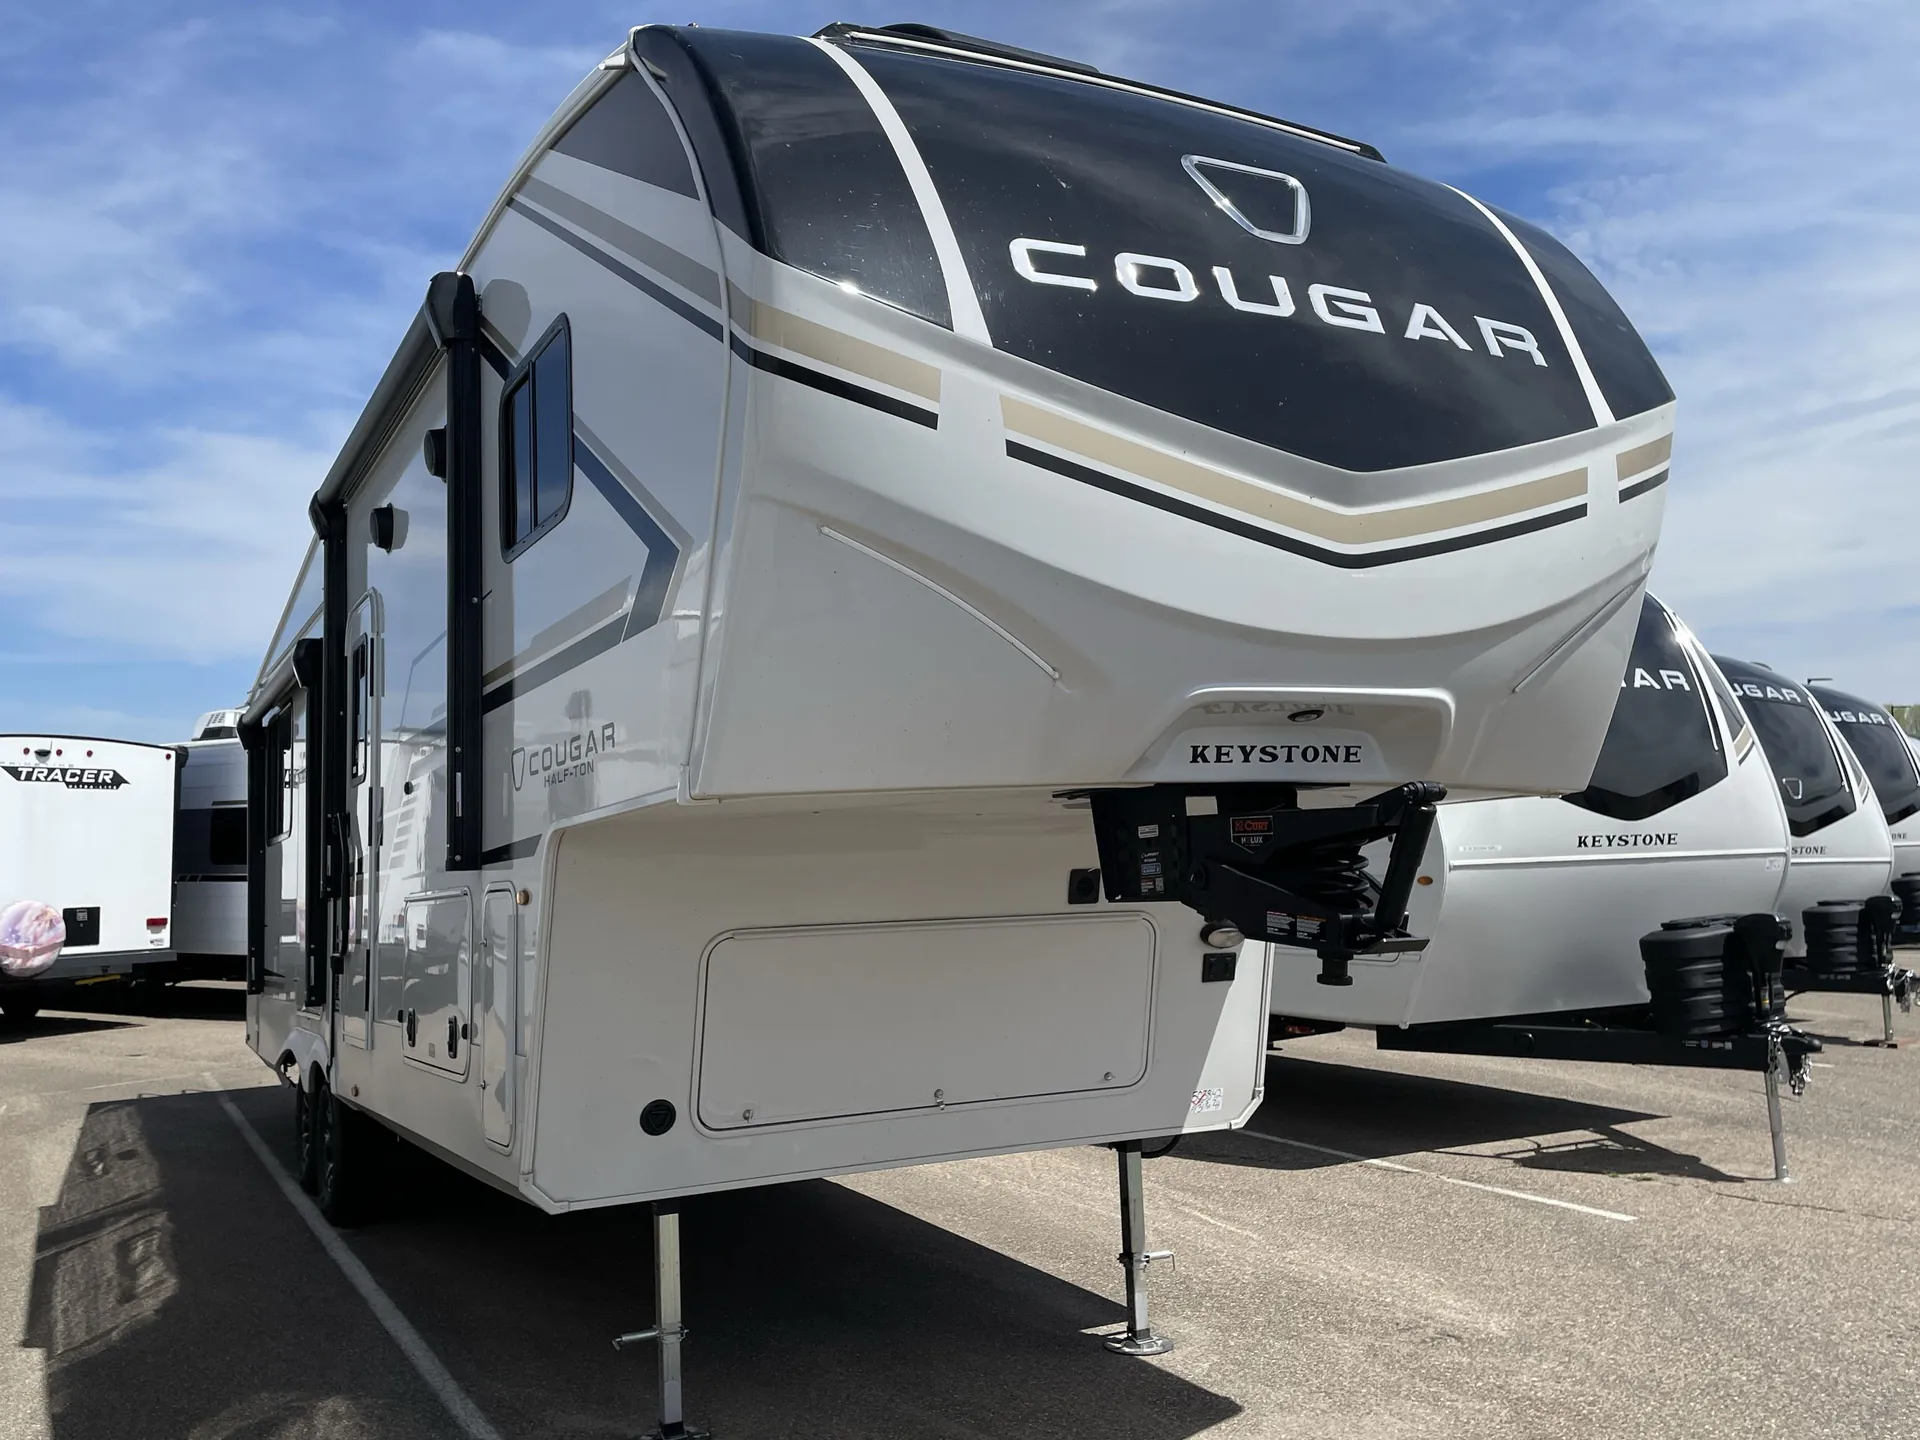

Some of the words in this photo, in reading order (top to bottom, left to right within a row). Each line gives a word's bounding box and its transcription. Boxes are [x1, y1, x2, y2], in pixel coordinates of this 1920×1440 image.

[1009, 237, 1549, 368] COUGAR
[1621, 668, 1691, 691] AR
[529, 722, 615, 776] COUGAR
[1189, 745, 1362, 763] KEYSTONE
[17, 767, 114, 784] TRACER
[544, 759, 594, 788] HALF-TON
[1577, 833, 1678, 848] KEYSTONE
[1791, 846, 1826, 855] STONE
